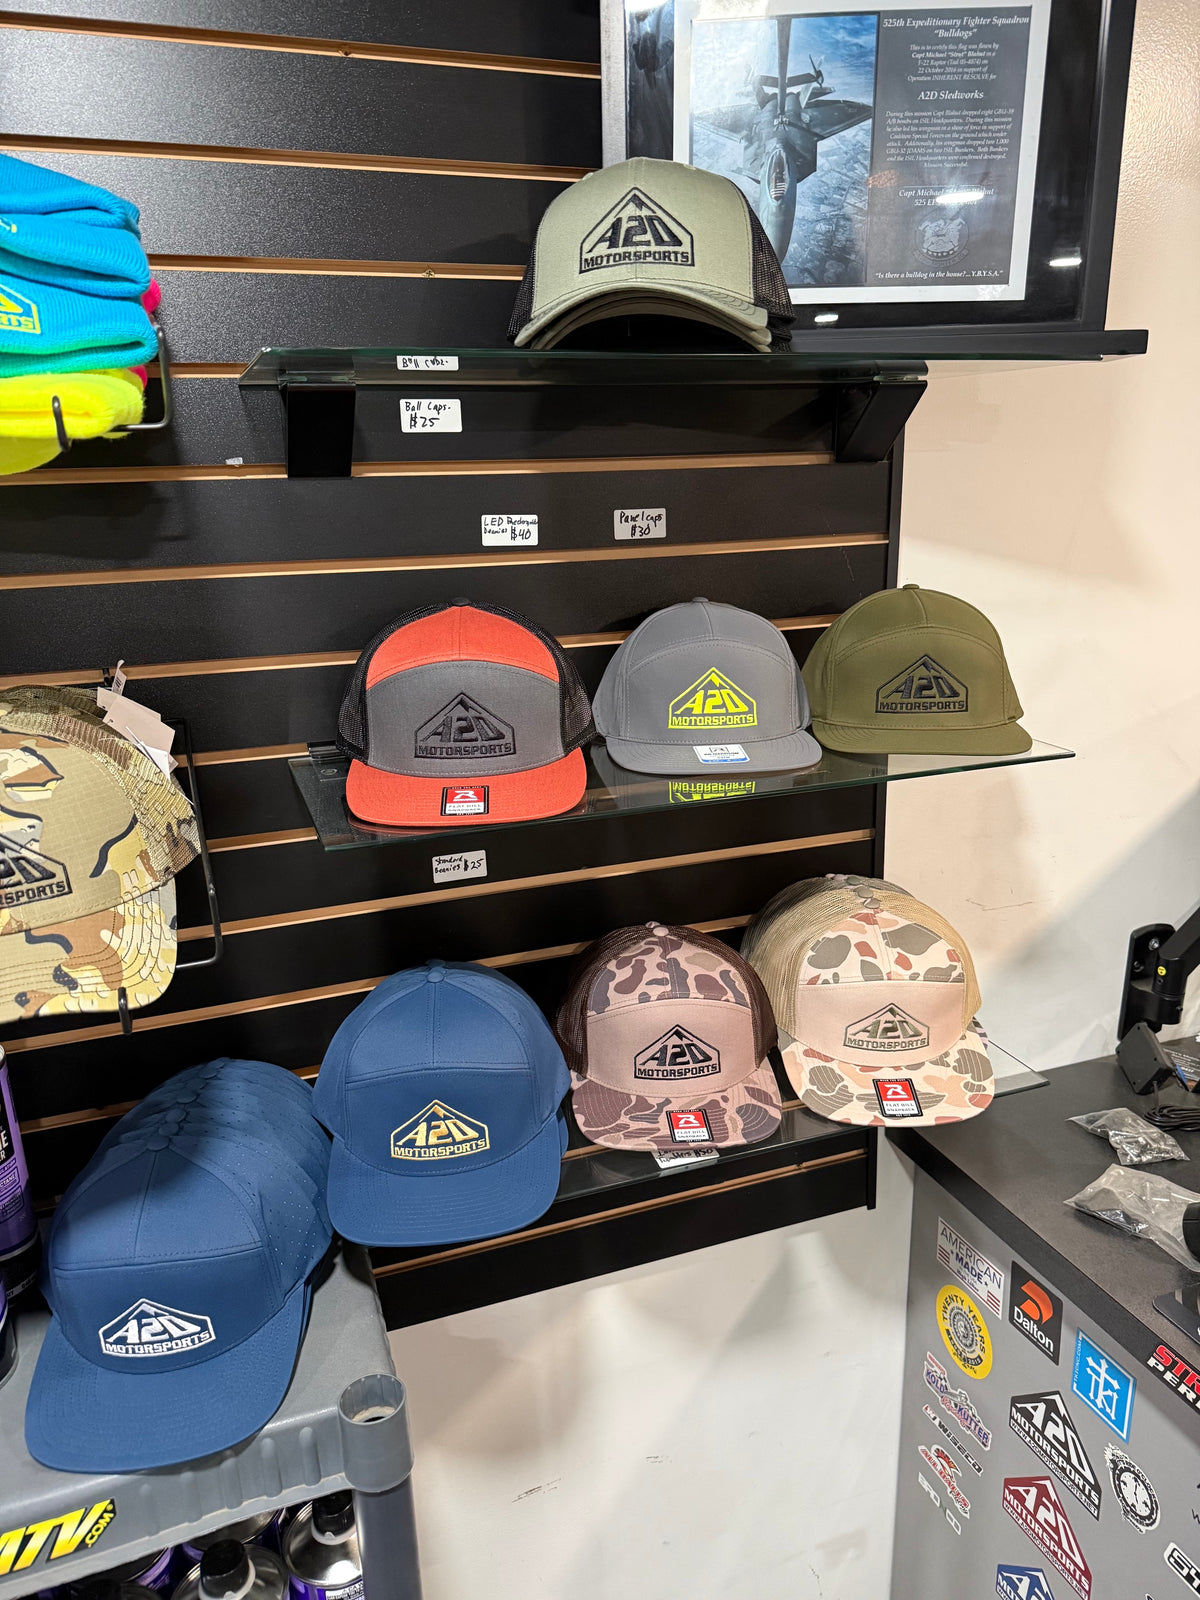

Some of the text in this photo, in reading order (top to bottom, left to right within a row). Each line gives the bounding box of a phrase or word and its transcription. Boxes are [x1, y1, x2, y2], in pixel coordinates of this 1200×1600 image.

[882, 15, 1030, 28] 525th Expeditionary Fighter Squadron
[917, 89, 984, 100] A2D Sledworks
[899, 189, 915, 198] Capt
[585, 214, 683, 254] A2D
[583, 250, 689, 269] MOTORSPORTS
[405, 400, 422, 412] Ball
[409, 412, 440, 429] $25
[484, 516, 504, 527] LED
[510, 525, 531, 541] $40
[630, 523, 651, 538] $30
[882, 675, 960, 699] A2D
[674, 689, 749, 714] A2D
[879, 700, 965, 711] MOTORSPORTS
[420, 715, 506, 743] A2D
[672, 713, 754, 726] MOTORSPORTS
[418, 742, 512, 756] MOTORSPORTS
[463, 858, 484, 872] $25
[849, 1019, 923, 1039] A2D
[639, 1042, 713, 1067] A2D
[846, 1037, 927, 1049] MOTORSPORTS
[637, 1063, 718, 1078] MOTORSPORTS
[395, 1119, 480, 1147] A2D
[394, 1138, 486, 1158] MOTORSPORTS
[940, 1227, 1002, 1290] AMERICAN
[955, 1253, 984, 1284] MADE
[105, 1315, 201, 1344] A2D
[942, 1293, 964, 1321] TWENTY
[968, 1305, 986, 1353] YEARS
[1013, 1305, 1054, 1353] Dalton
[105, 1330, 210, 1354] MOTORSPORTS
[957, 1404, 989, 1444] KUTTER
[938, 1420, 983, 1474] WISECO
[1014, 1401, 1095, 1485] A2D
[1011, 1406, 1099, 1506] MOTORSPORTS
[1004, 1488, 1090, 1591] MOTORSPORTS
[1007, 1485, 1086, 1571] A2D
